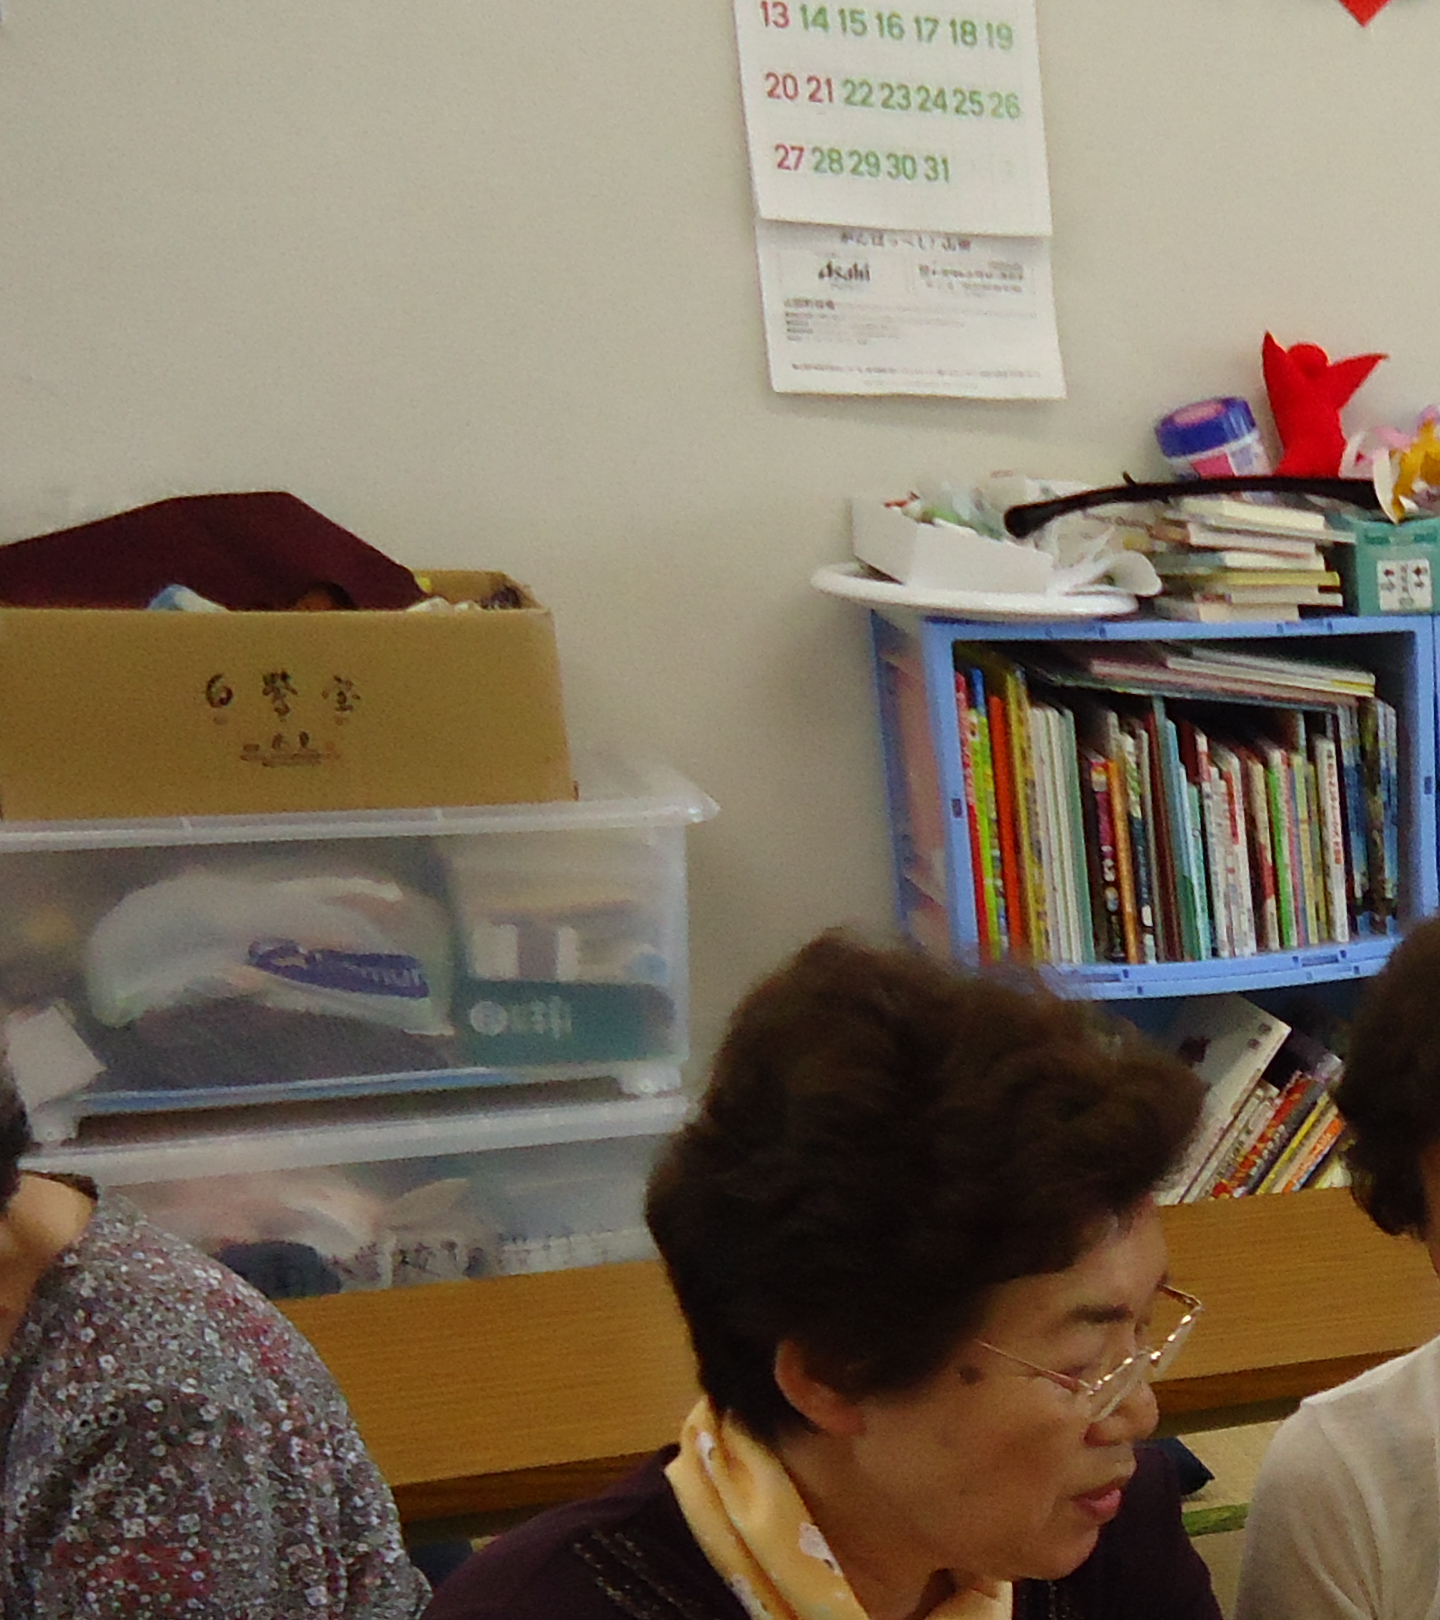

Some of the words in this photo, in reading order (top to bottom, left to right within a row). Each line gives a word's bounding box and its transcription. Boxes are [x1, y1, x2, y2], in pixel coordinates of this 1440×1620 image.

[760, 2, 790, 29] 13
[801, 6, 829, 33] 14
[838, 8, 868, 37] 15
[876, 12, 905, 41] 16
[914, 16, 939, 44] 17
[949, 19, 978, 47] 18
[986, 22, 1014, 51] 19
[765, 72, 799, 101] 20
[806, 76, 834, 103] 21
[842, 79, 873, 108] 22
[880, 82, 912, 111] 23
[917, 85, 949, 114] 24
[952, 88, 985, 117] 25
[990, 92, 1021, 120] 26
[774, 144, 805, 171] 27
[811, 147, 843, 175] 28
[849, 150, 881, 178] 29
[886, 153, 918, 181] 30
[924, 156, 950, 183] 31
